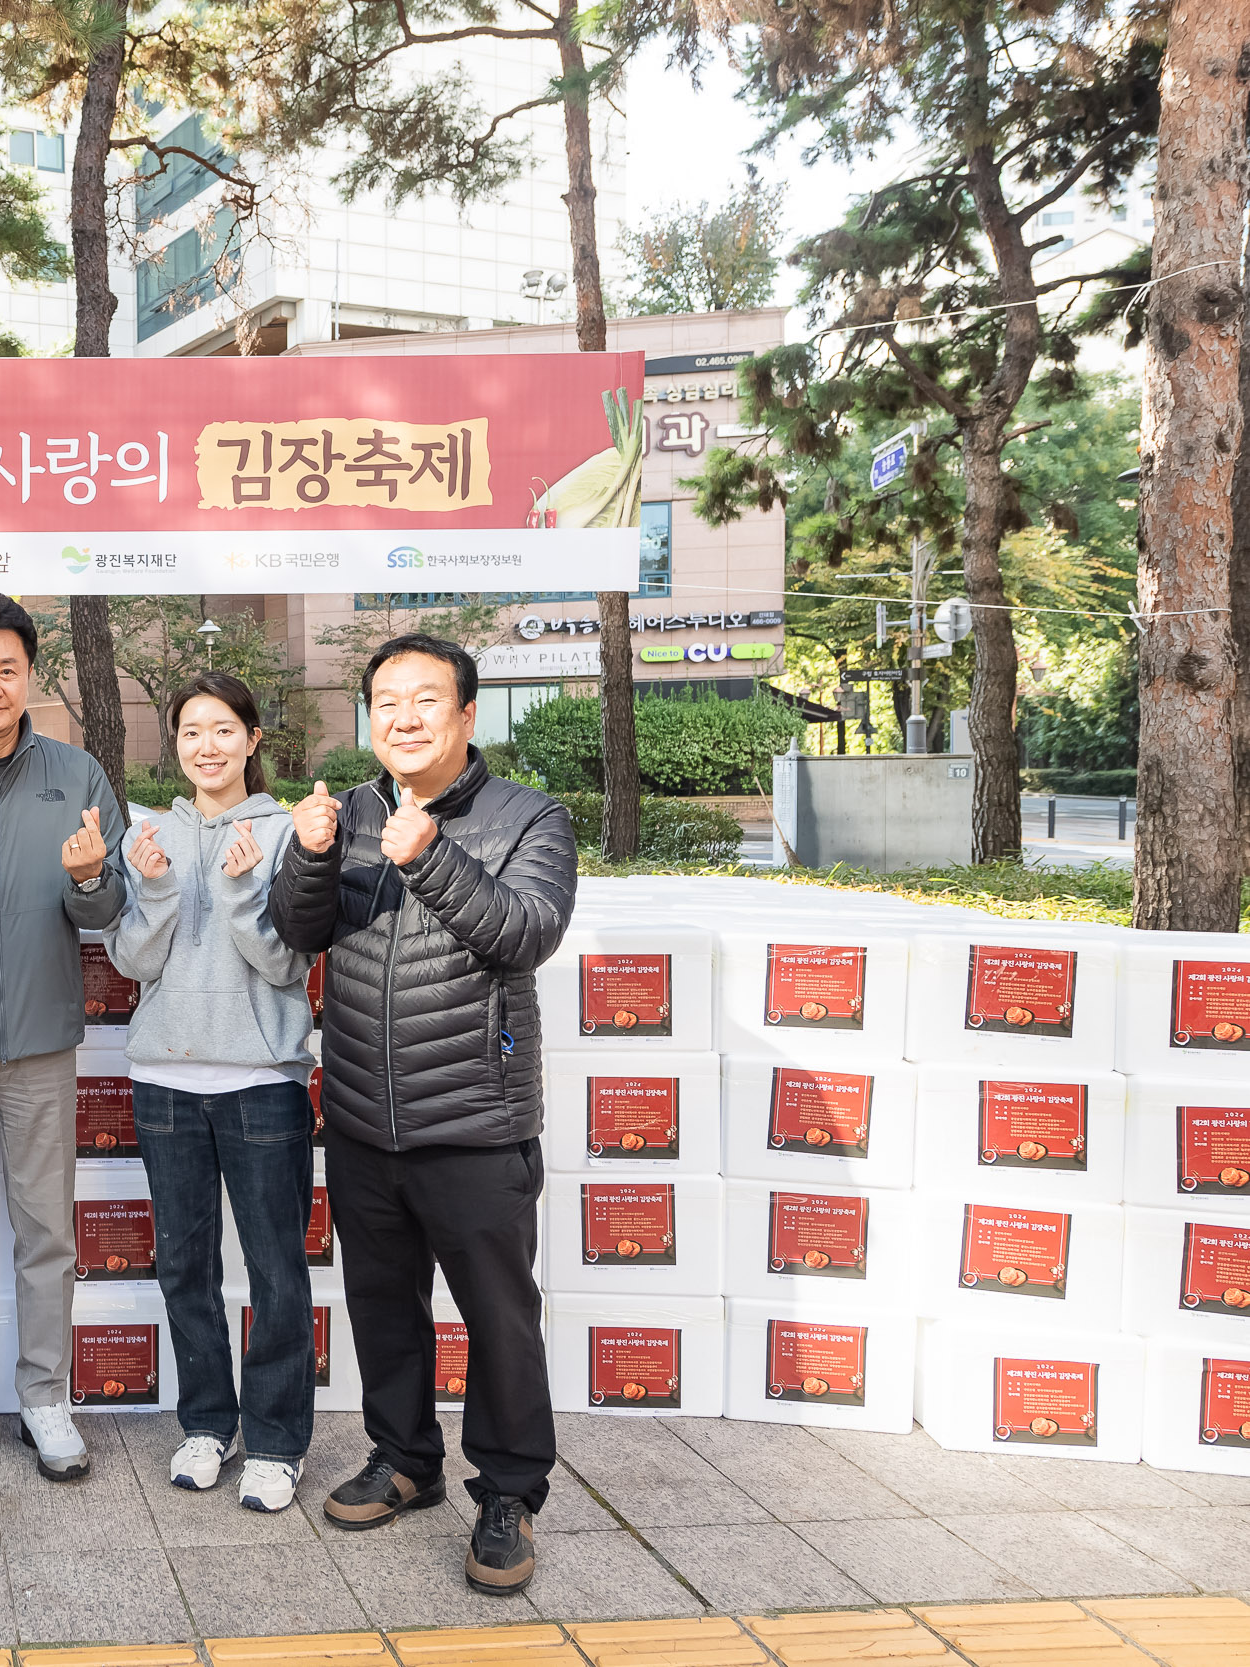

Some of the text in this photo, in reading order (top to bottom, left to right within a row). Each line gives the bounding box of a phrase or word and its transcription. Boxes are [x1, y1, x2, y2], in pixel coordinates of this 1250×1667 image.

[652, 412, 708, 456] 과
[216, 427, 472, 505] 김장축제
[95, 553, 178, 568] 광진복지재단
[427, 554, 522, 567] 한국사회보장정보원
[494, 652, 601, 665] WHY PILATE
[688, 642, 727, 663] CU
[954, 768, 967, 777] 10
[637, 966, 659, 974] 김장축제
[983, 958, 1062, 971] 제2회 광진 사랑의 김장축제
[644, 1089, 667, 1097] 김장축제
[785, 1080, 860, 1094] 제2회 광진 사랑의 김장축제
[1025, 1095, 1046, 1103] 사랑의
[1047, 1096, 1074, 1104] 김장축제
[782, 1204, 798, 1212] 제2회
[812, 1206, 831, 1214] 사랑의
[831, 1208, 856, 1216] 김장축제
[977, 1218, 1057, 1233] 제2회 광진 사랑의 김장축제
[646, 1339, 668, 1347] 김장축제
[810, 1333, 828, 1342] 사랑의
[829, 1335, 853, 1344] 김장축제
[1024, 1371, 1037, 1379] 광진
[1037, 1371, 1057, 1380] 사랑의
[1058, 1372, 1083, 1381] 김장축제
